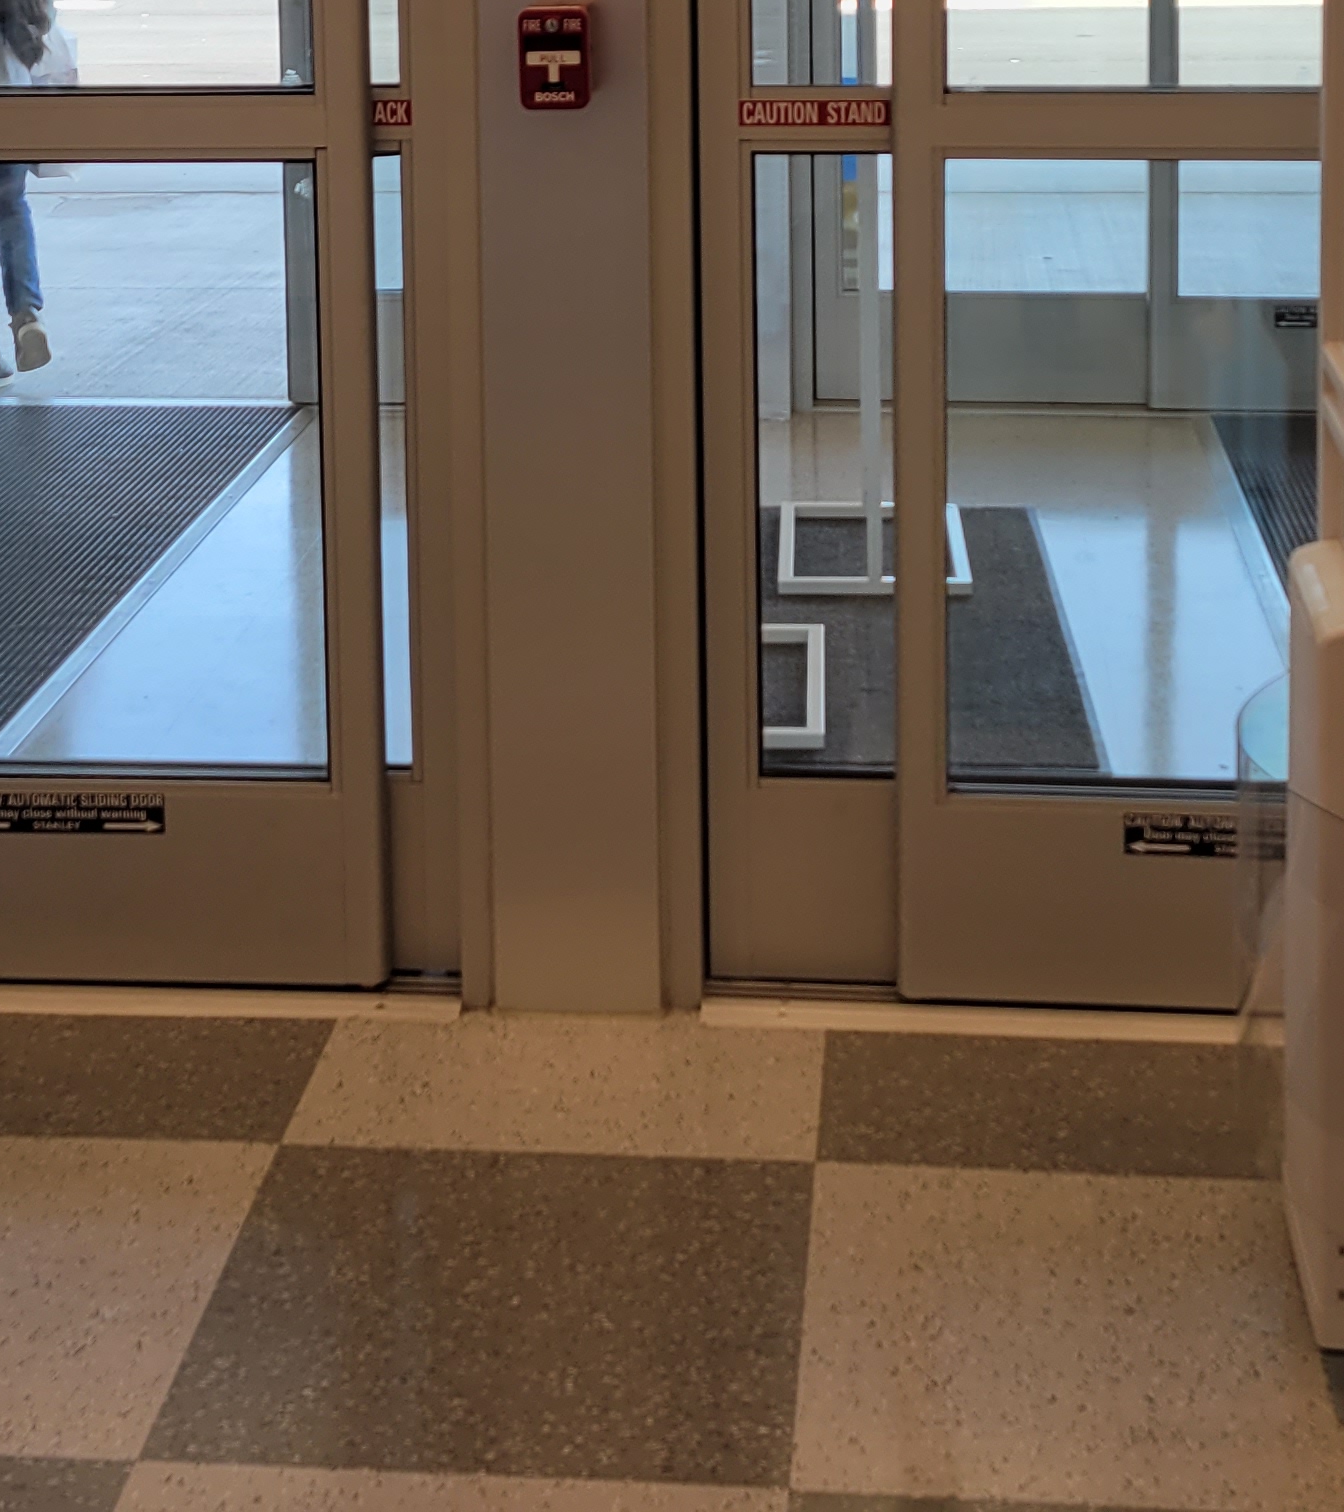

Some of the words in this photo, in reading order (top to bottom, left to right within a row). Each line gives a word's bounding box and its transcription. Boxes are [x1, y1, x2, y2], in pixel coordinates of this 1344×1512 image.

[534, 91, 575, 102] BOSCH
[373, 101, 409, 124] ACK
[741, 101, 820, 124] CAUTION
[826, 101, 887, 124] STAND
[131, 792, 165, 806] DOOR
